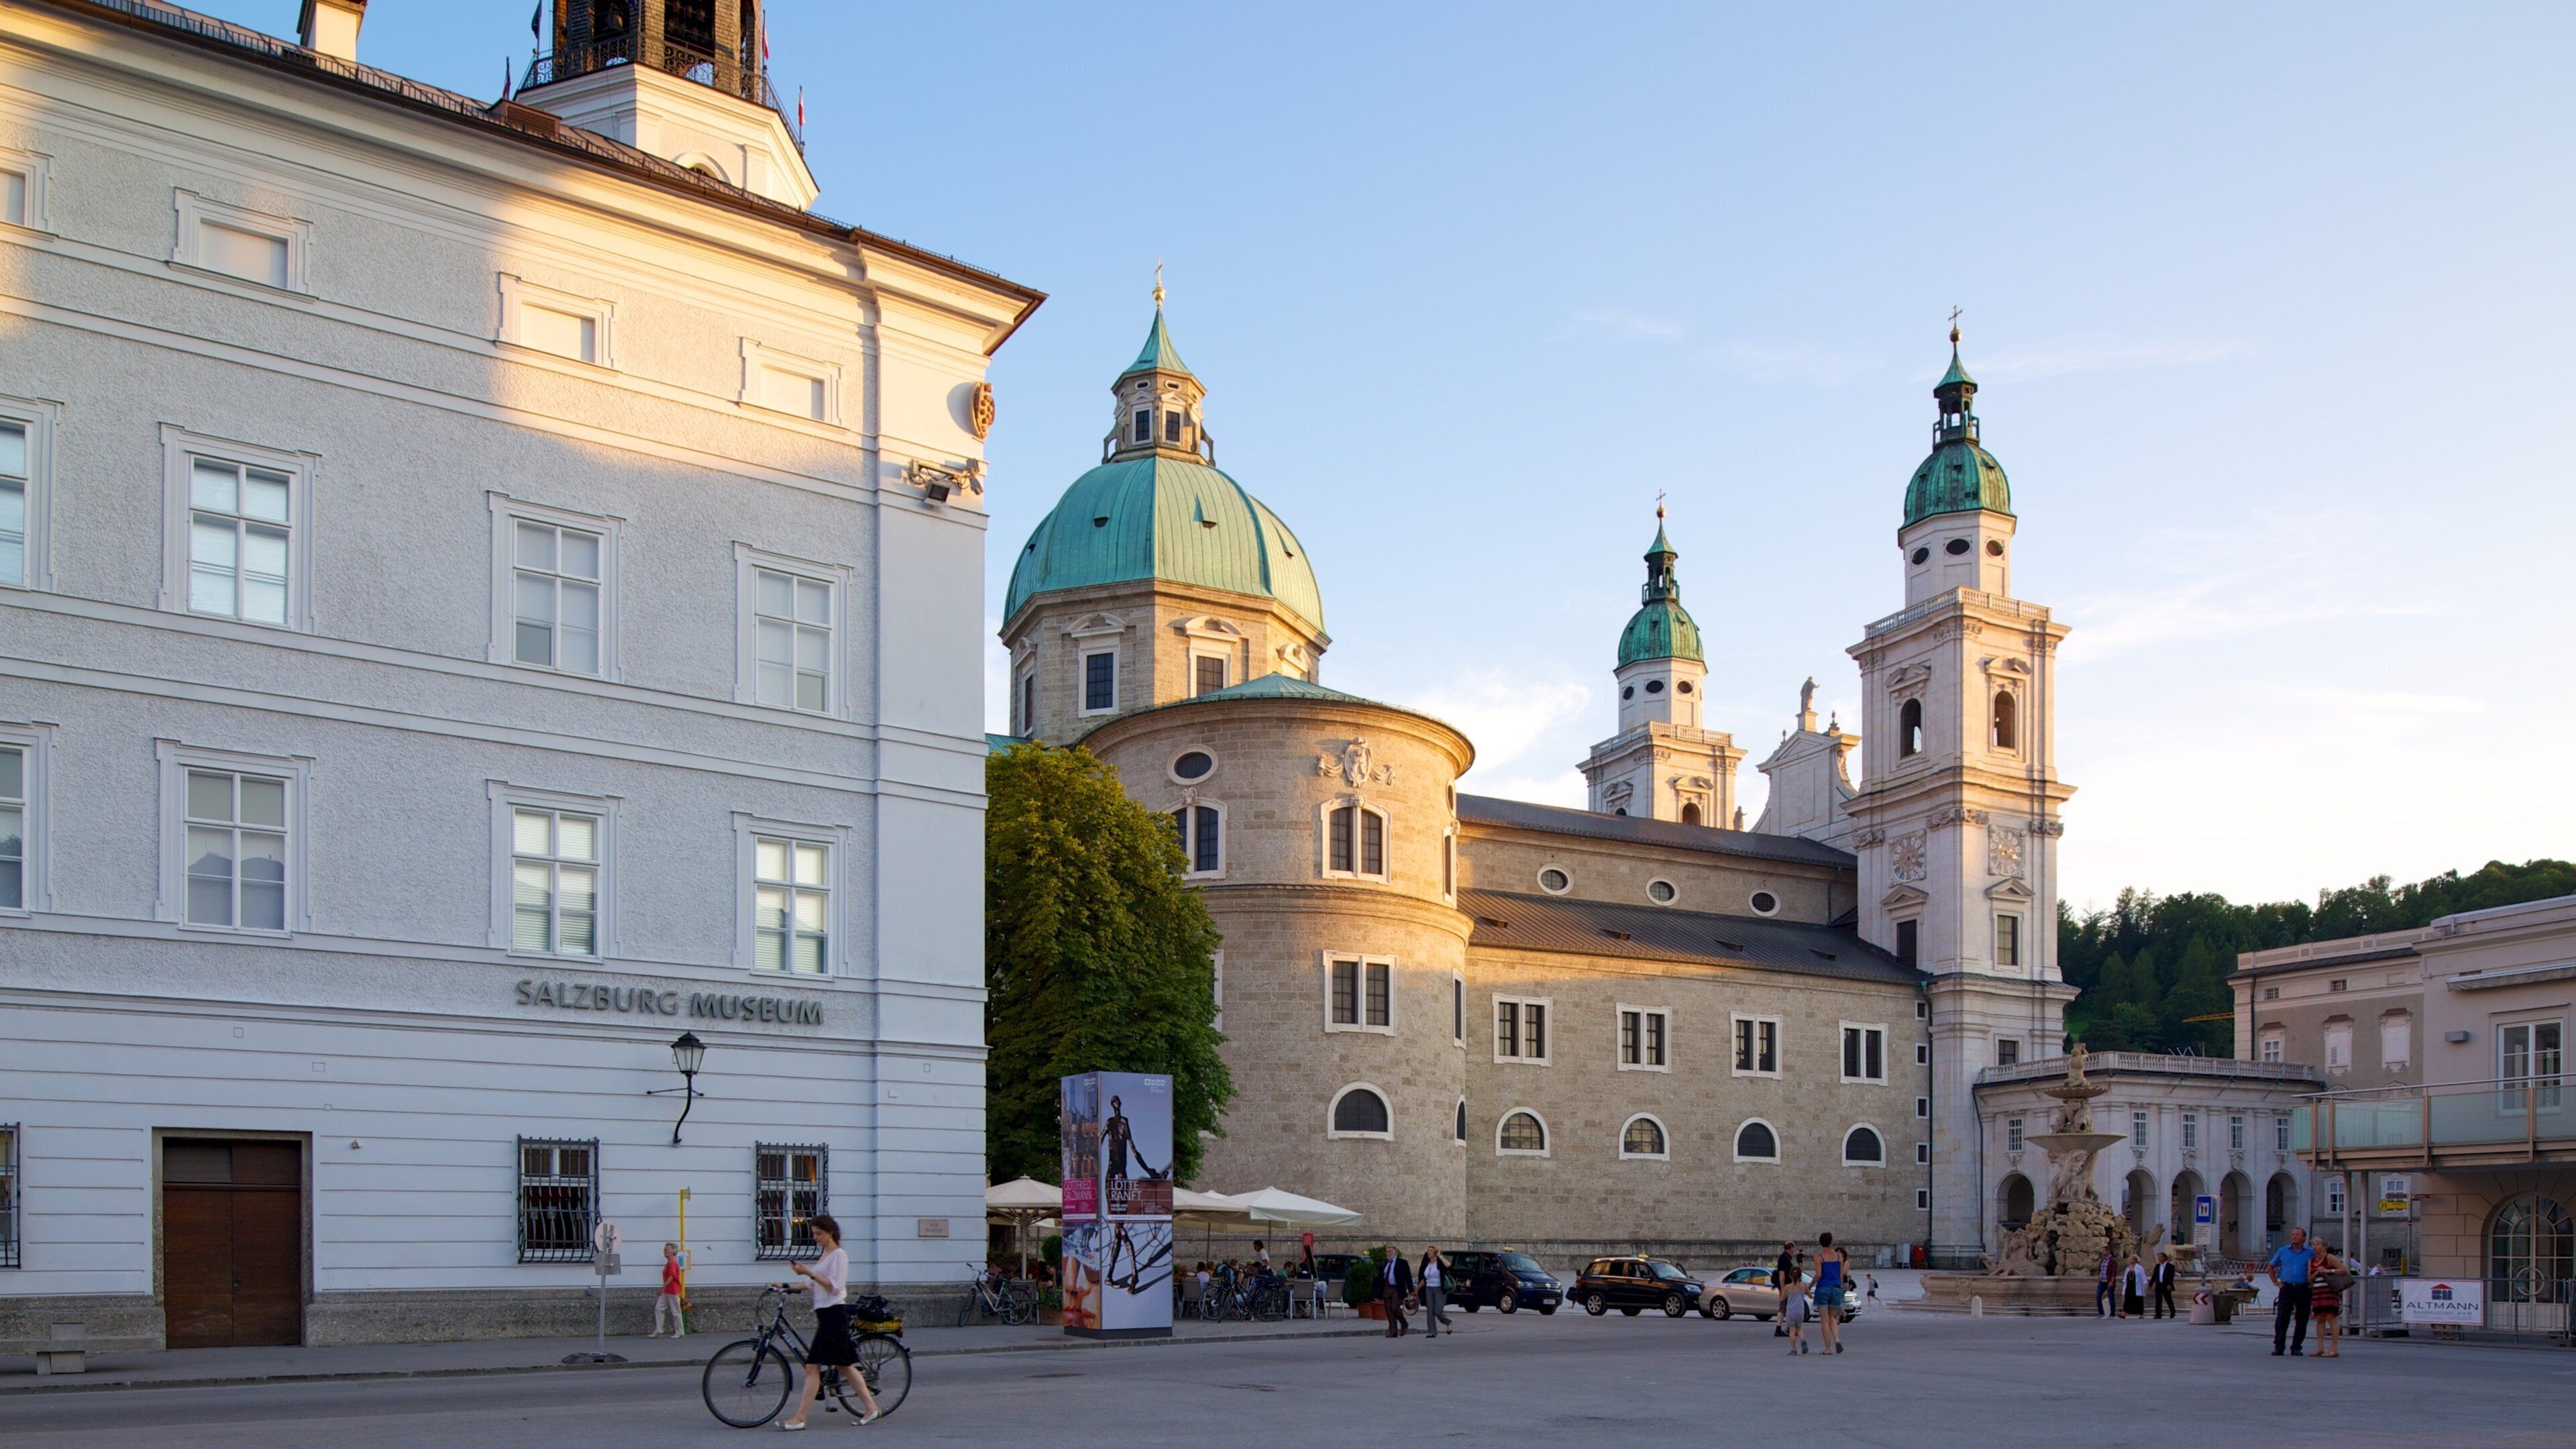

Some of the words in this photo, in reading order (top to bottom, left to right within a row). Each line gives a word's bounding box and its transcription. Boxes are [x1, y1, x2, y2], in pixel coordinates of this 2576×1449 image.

[516, 979, 678, 1015] SALZBURG
[690, 991, 824, 1025] MUSEUM
[1064, 1180, 1091, 1190] GOTTFRIED
[1111, 1180, 1139, 1190] LOTTE
[1064, 1190, 1091, 1200] SALZMANN
[1111, 1191, 1142, 1201] RANFT
[2406, 1301, 2479, 1310] ALTMANN
